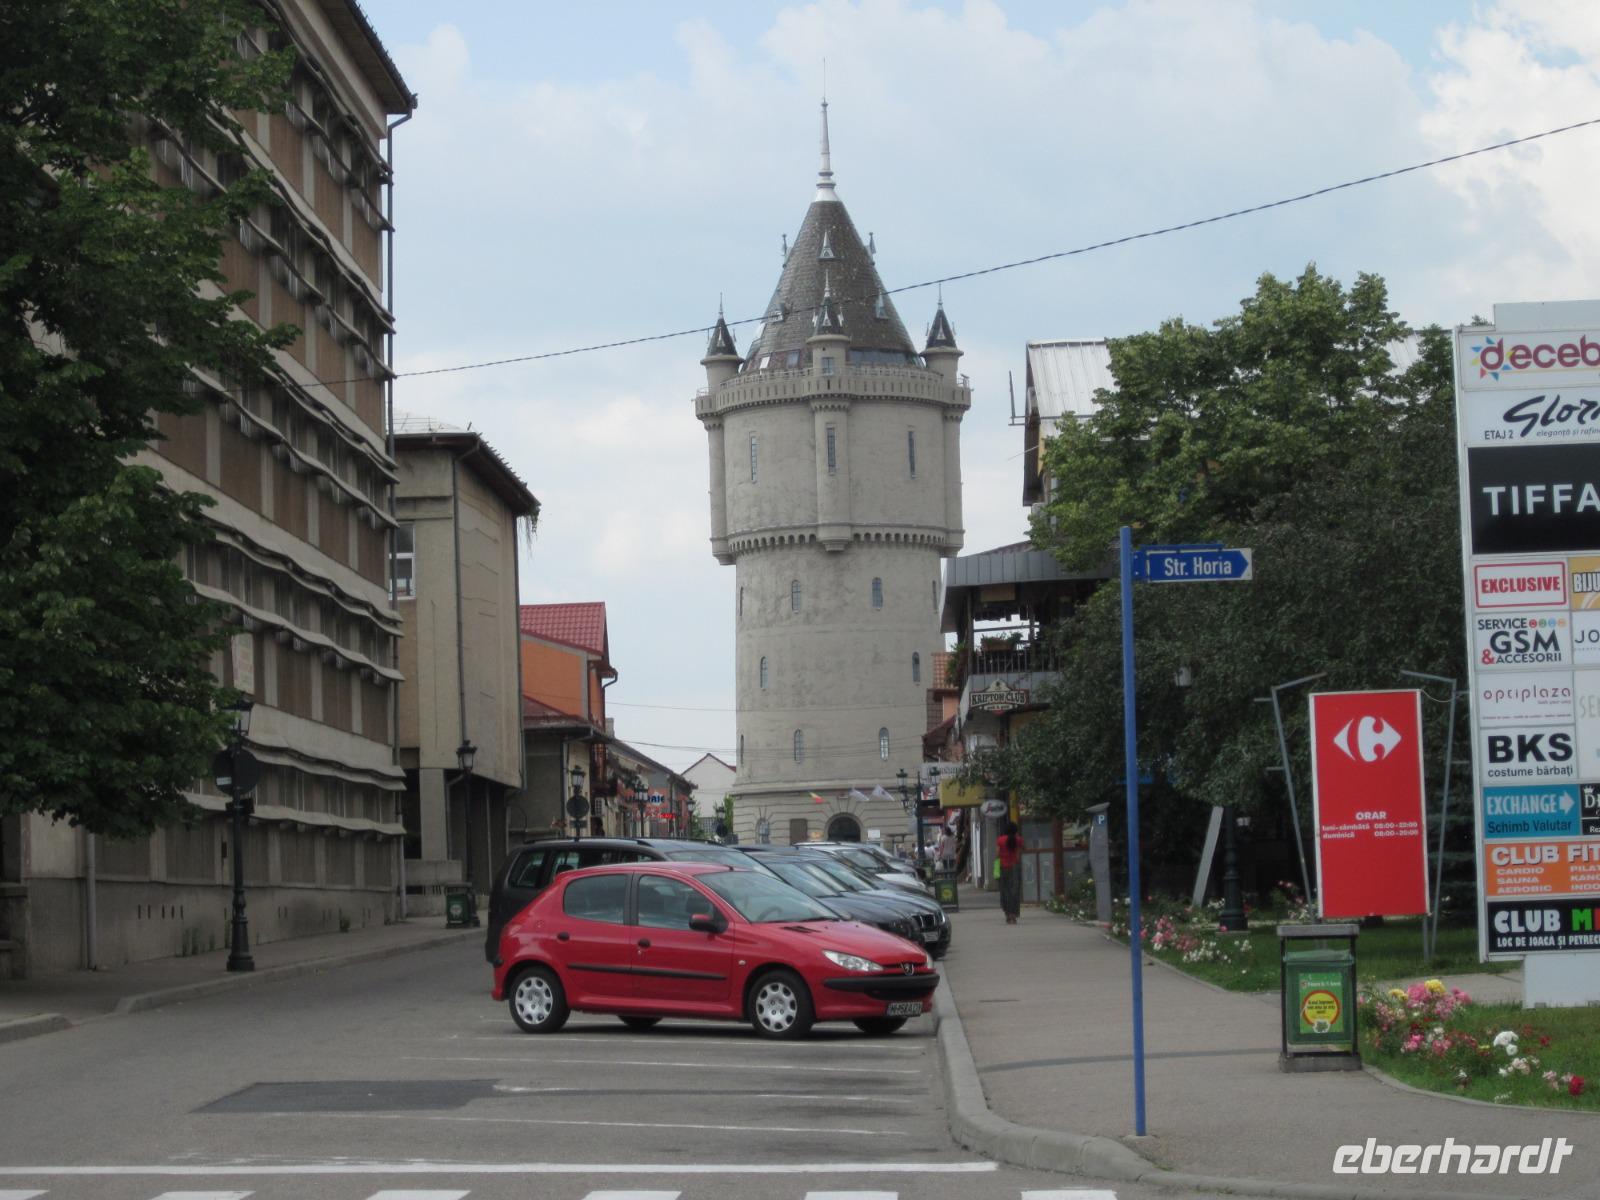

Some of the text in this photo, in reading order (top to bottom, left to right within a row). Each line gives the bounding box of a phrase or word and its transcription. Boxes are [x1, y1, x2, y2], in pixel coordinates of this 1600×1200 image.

[1485, 430, 1514, 440] ETAJ 2
[1164, 556, 1232, 577] Str. Horia
[1481, 576, 1560, 593] EXCLUSIVE
[1478, 618, 1527, 630] SERVICE
[1490, 629, 1560, 654] GSM
[1482, 649, 1562, 665] & ACCESORII
[1483, 684, 1571, 703] optiplaza
[1488, 732, 1573, 763] BKS
[1488, 766, 1533, 777] costume
[1486, 794, 1558, 815] EXCHANGE
[1356, 811, 1386, 820] ORAR
[1488, 819, 1572, 834] Schimb Valutar
[1491, 846, 1559, 866] CLUB
[1496, 867, 1544, 875] CARDIO
[1494, 909, 1560, 933] CLUB
[1497, 937, 1512, 947] LOC
[1516, 936, 1526, 947] DE
